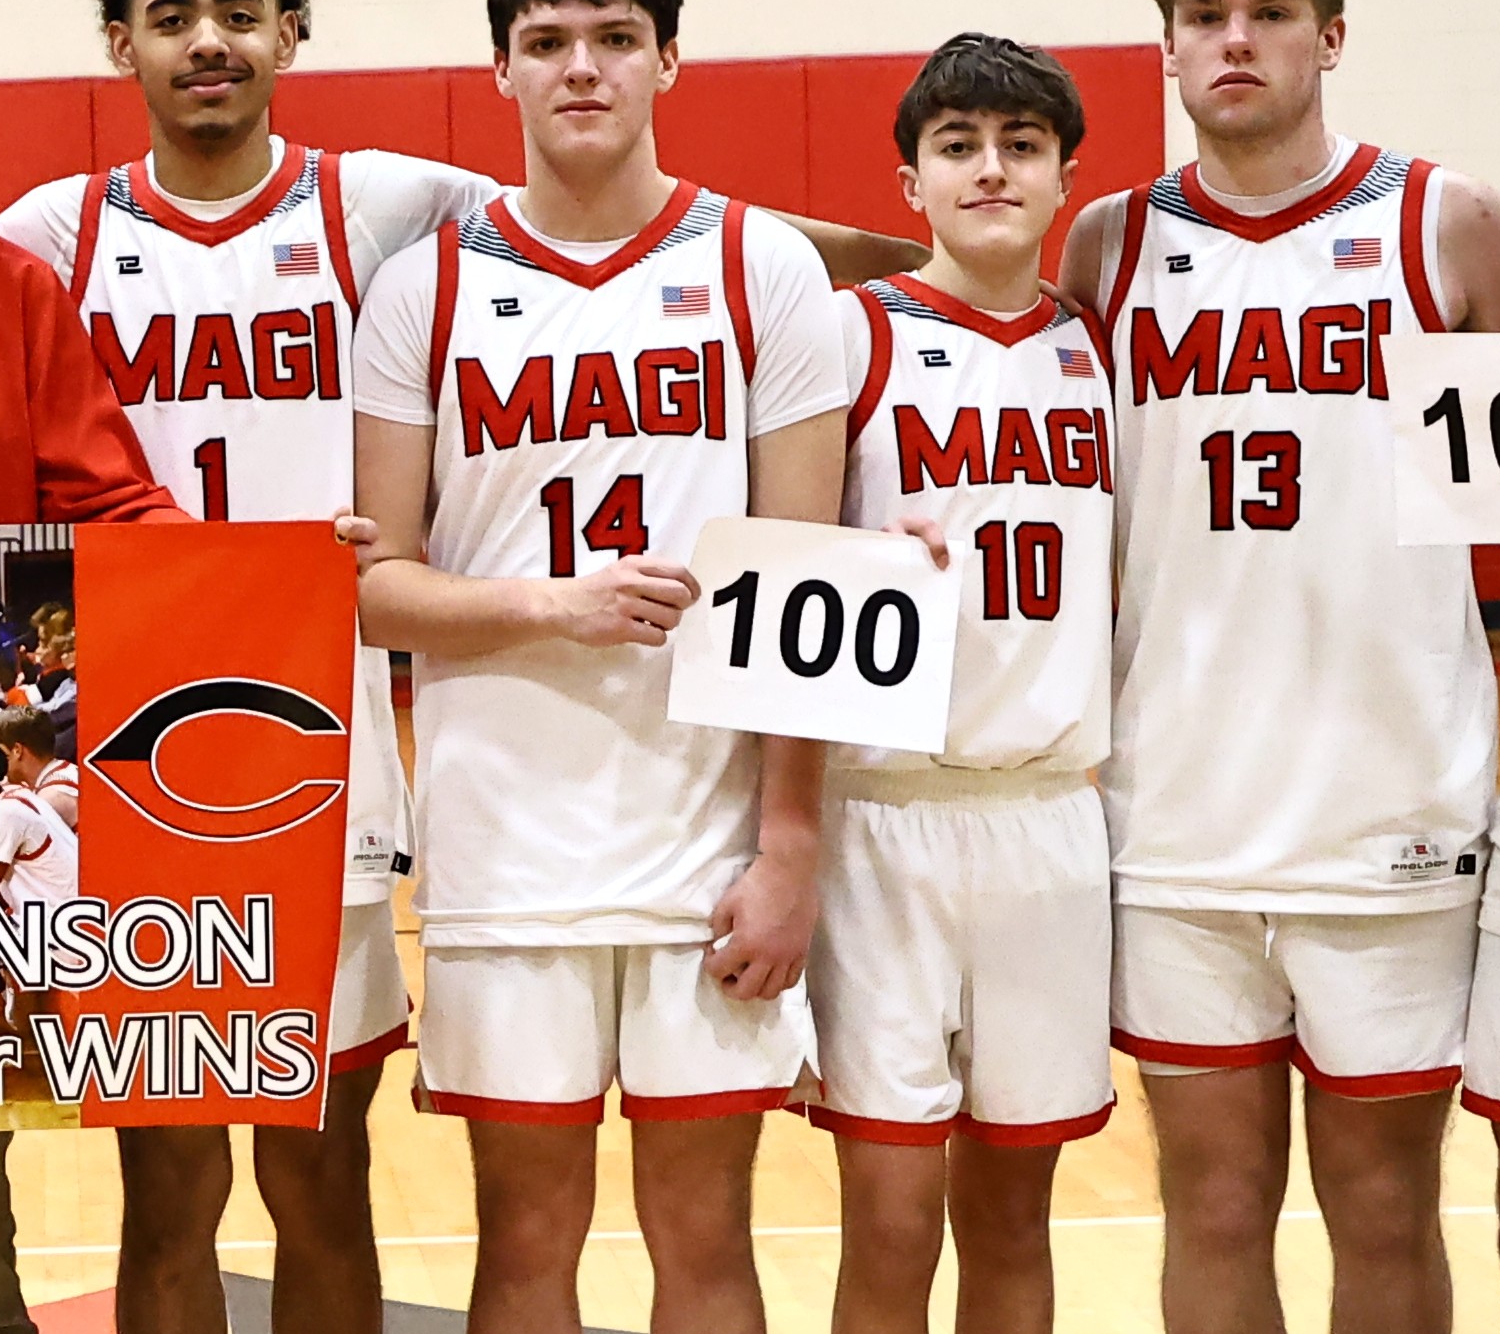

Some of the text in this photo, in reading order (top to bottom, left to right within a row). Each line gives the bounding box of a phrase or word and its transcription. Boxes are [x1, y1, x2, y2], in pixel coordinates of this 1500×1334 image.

[90, 301, 343, 407] MAGI
[456, 339, 726, 457] MAGI
[1131, 298, 1393, 408] MAGI
[193, 436, 229, 521] 1
[894, 404, 1114, 495] MAGI
[1200, 430, 1302, 532] 13
[539, 474, 649, 579] 14
[975, 519, 1063, 622] 10
[711, 570, 920, 687] 100
[33, 1010, 318, 1103] WINS
